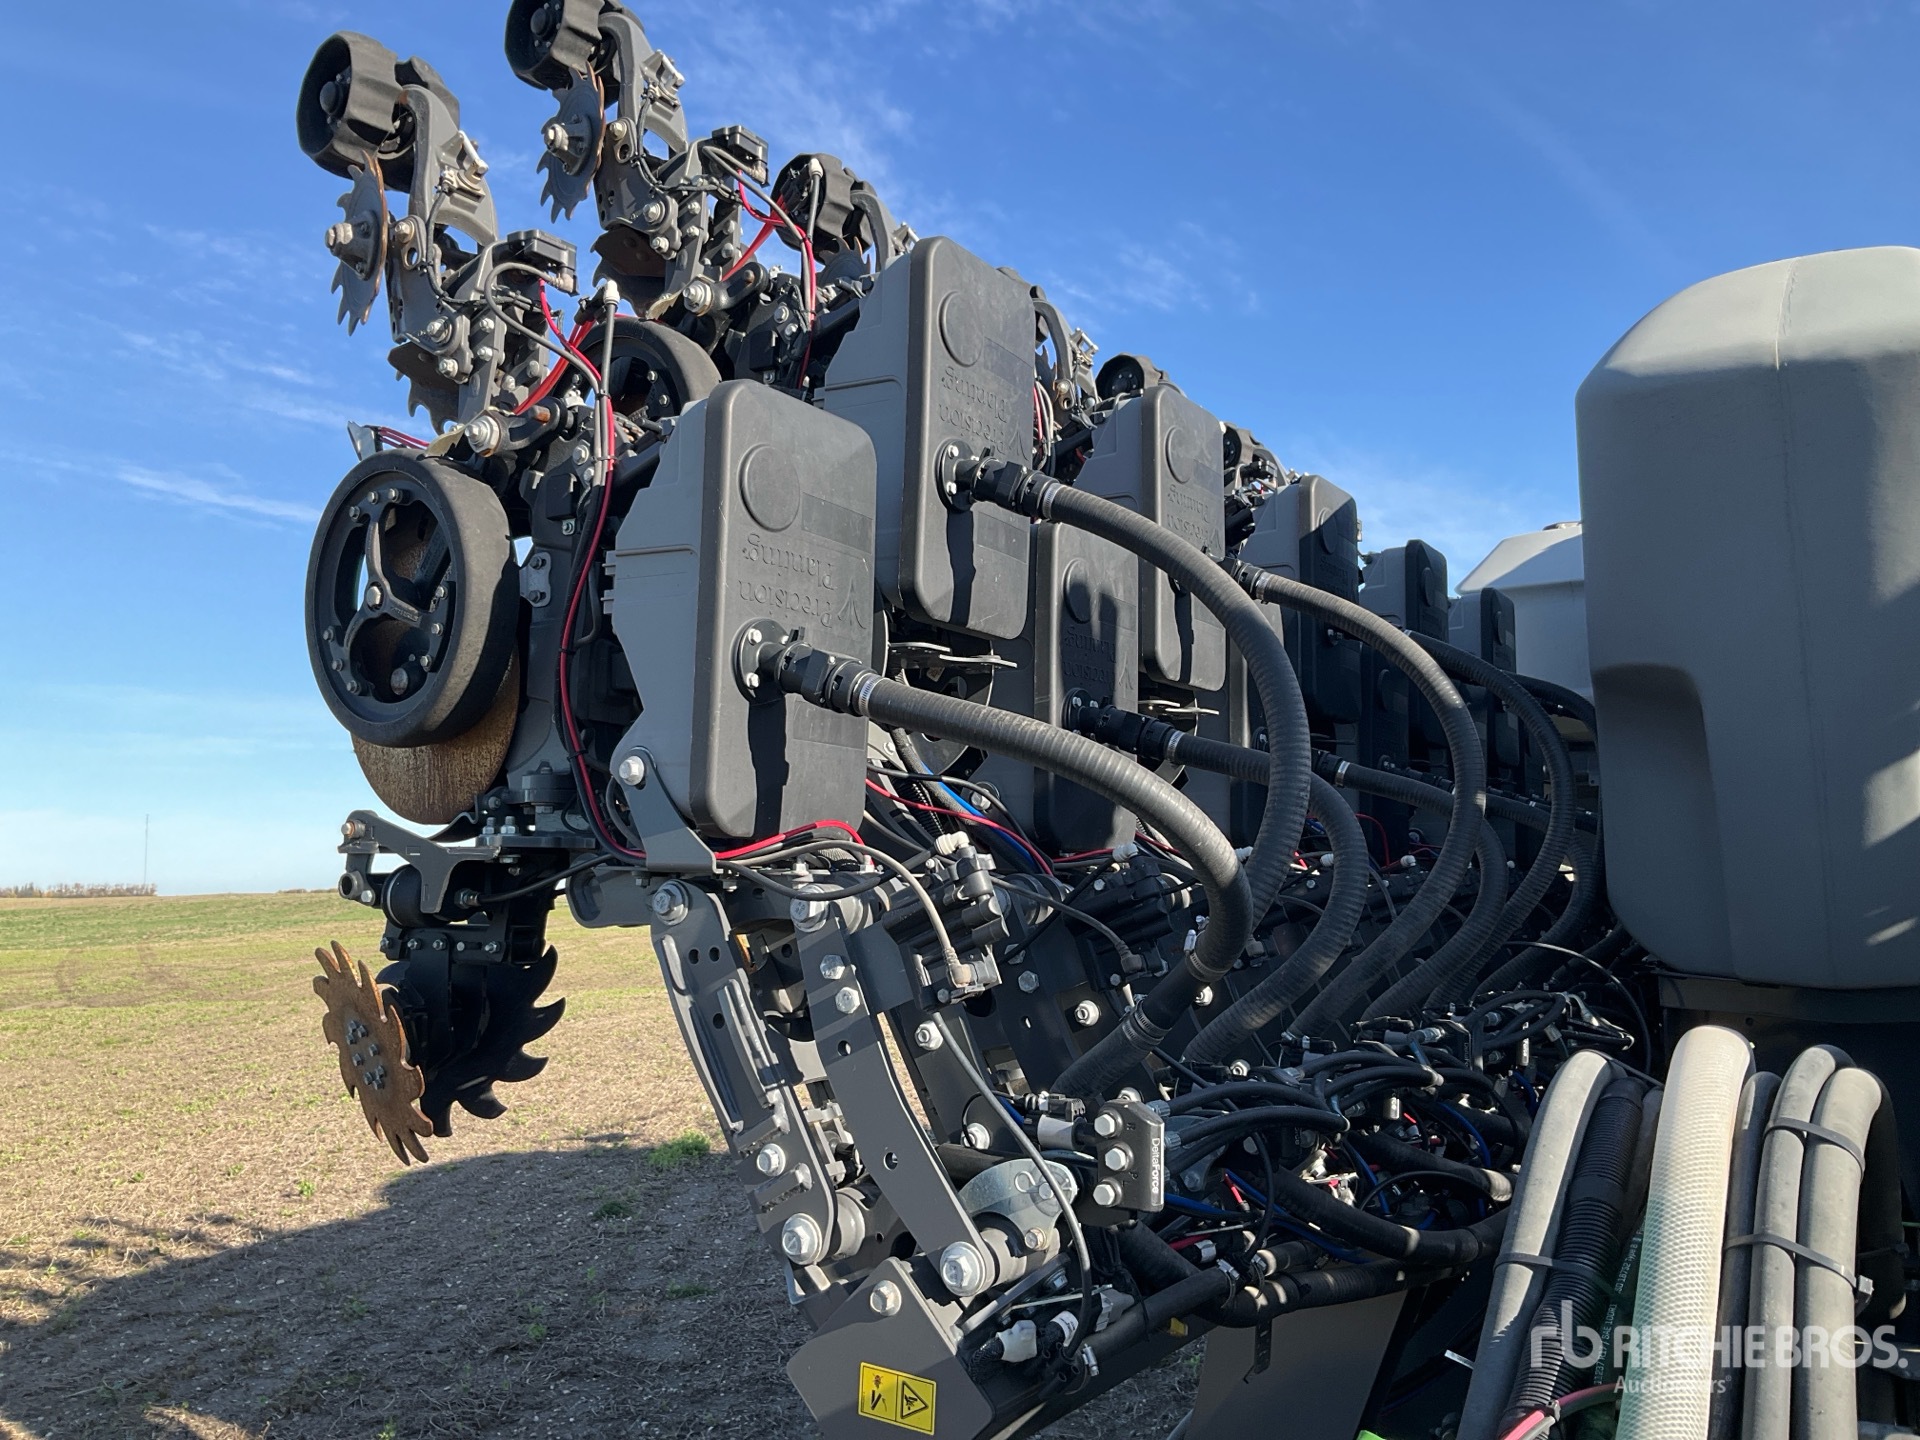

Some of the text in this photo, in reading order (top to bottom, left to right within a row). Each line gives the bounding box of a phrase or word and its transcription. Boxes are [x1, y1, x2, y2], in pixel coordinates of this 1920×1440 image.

[940, 365, 1009, 424] Planting
[938, 402, 1007, 456] Precision
[741, 532, 838, 591] Planting
[737, 579, 833, 629] Precision
[1151, 1138, 1161, 1194] DeltaForce
